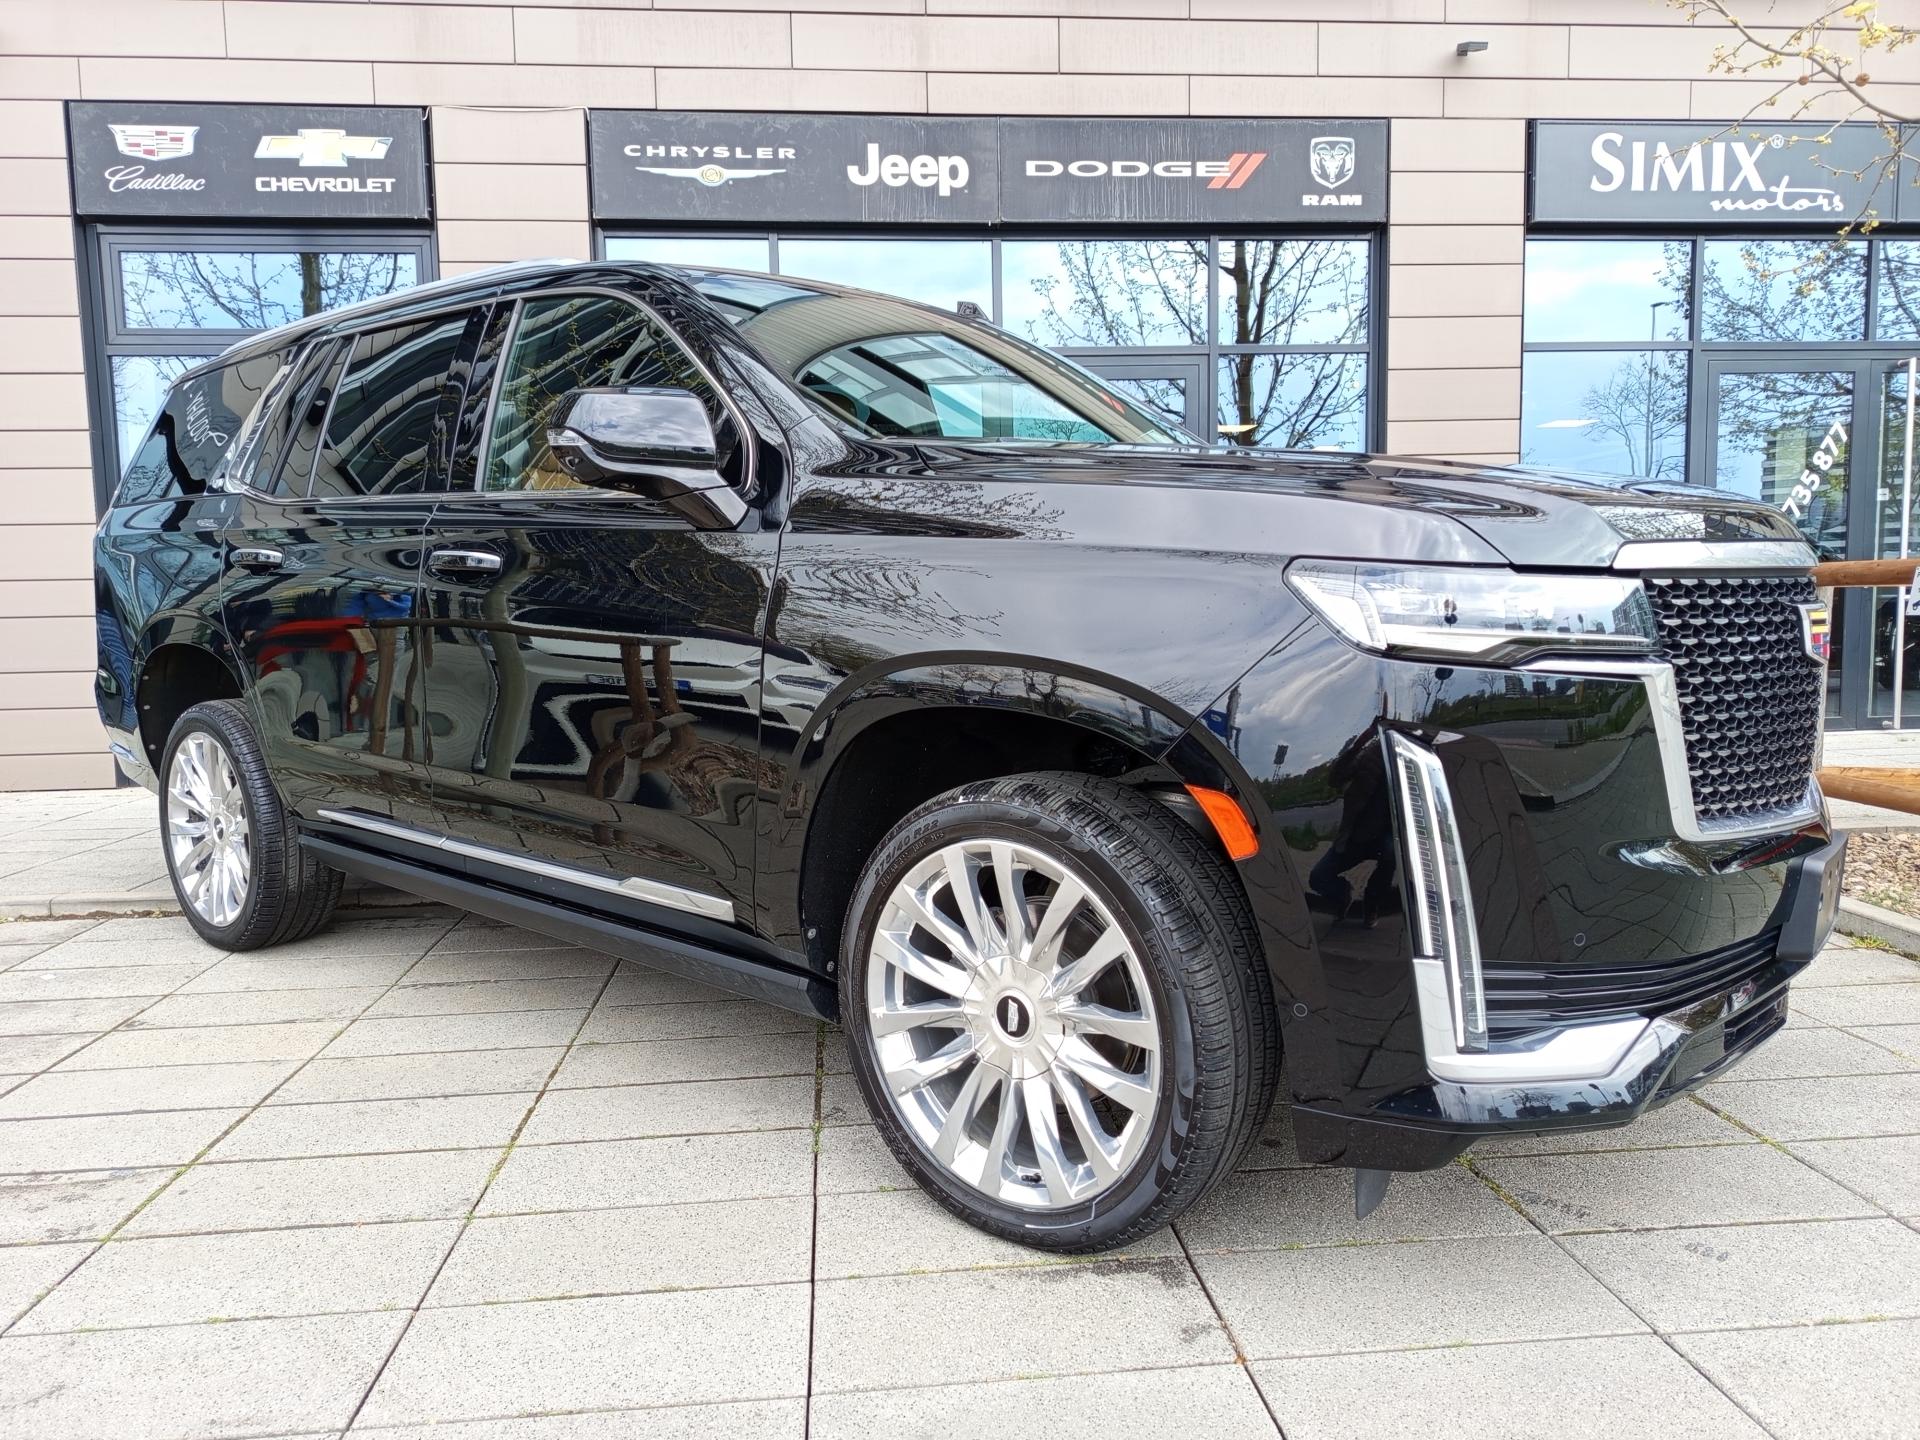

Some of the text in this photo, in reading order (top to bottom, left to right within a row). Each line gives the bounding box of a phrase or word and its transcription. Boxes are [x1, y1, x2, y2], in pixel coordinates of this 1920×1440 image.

[623, 144, 796, 160] CHRYSLER
[104, 165, 206, 193] Cadillac
[847, 143, 970, 197] Jeep
[1025, 160, 1231, 177] DODGE
[254, 176, 396, 193] CHEVROLET
[1710, 175, 1844, 211] motors
[1302, 194, 1363, 206] RAM
[1781, 421, 1848, 518] 735 877
[872, 834, 912, 881] 275/40
[912, 818, 940, 839] R22
